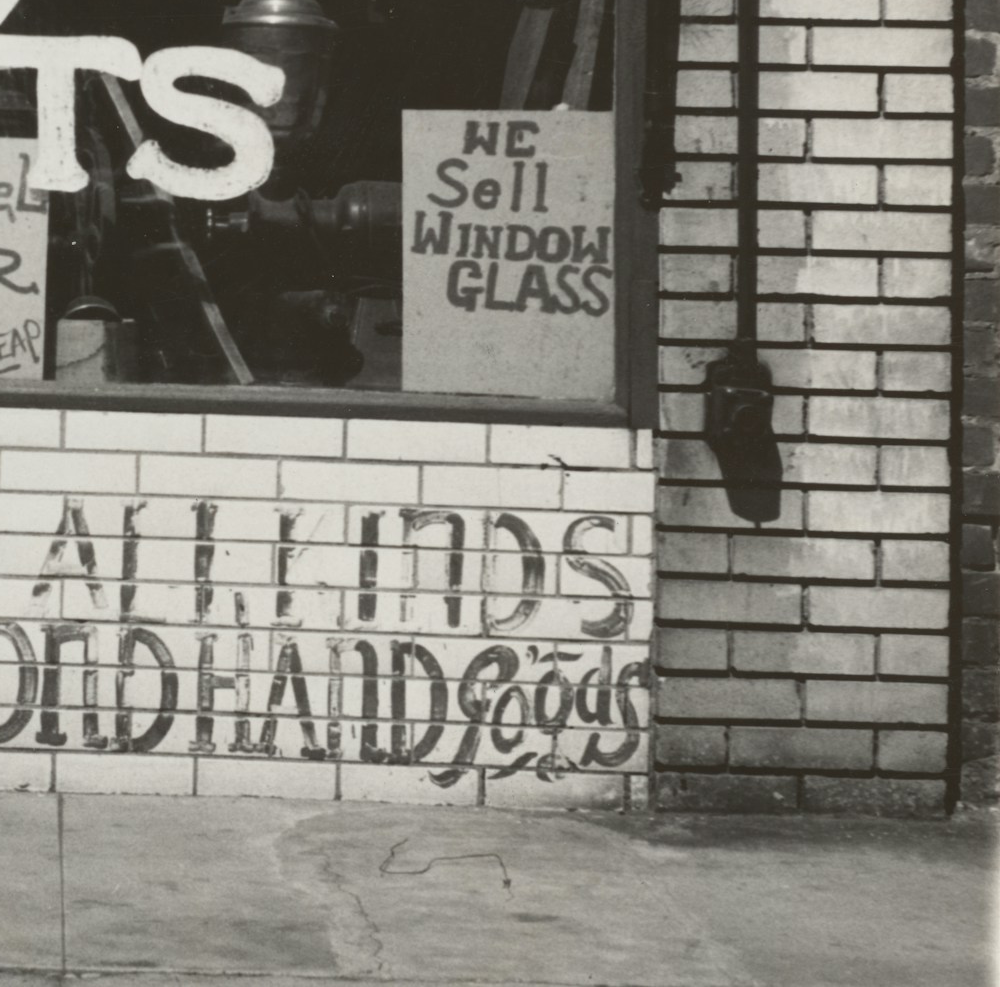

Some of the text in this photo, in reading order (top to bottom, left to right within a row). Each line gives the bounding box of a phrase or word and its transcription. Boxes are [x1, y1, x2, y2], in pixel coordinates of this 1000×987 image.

[462, 120, 540, 158] WE
[427, 157, 549, 213] Sell
[411, 210, 611, 265] WINDOW
[446, 260, 614, 317] GLASS
